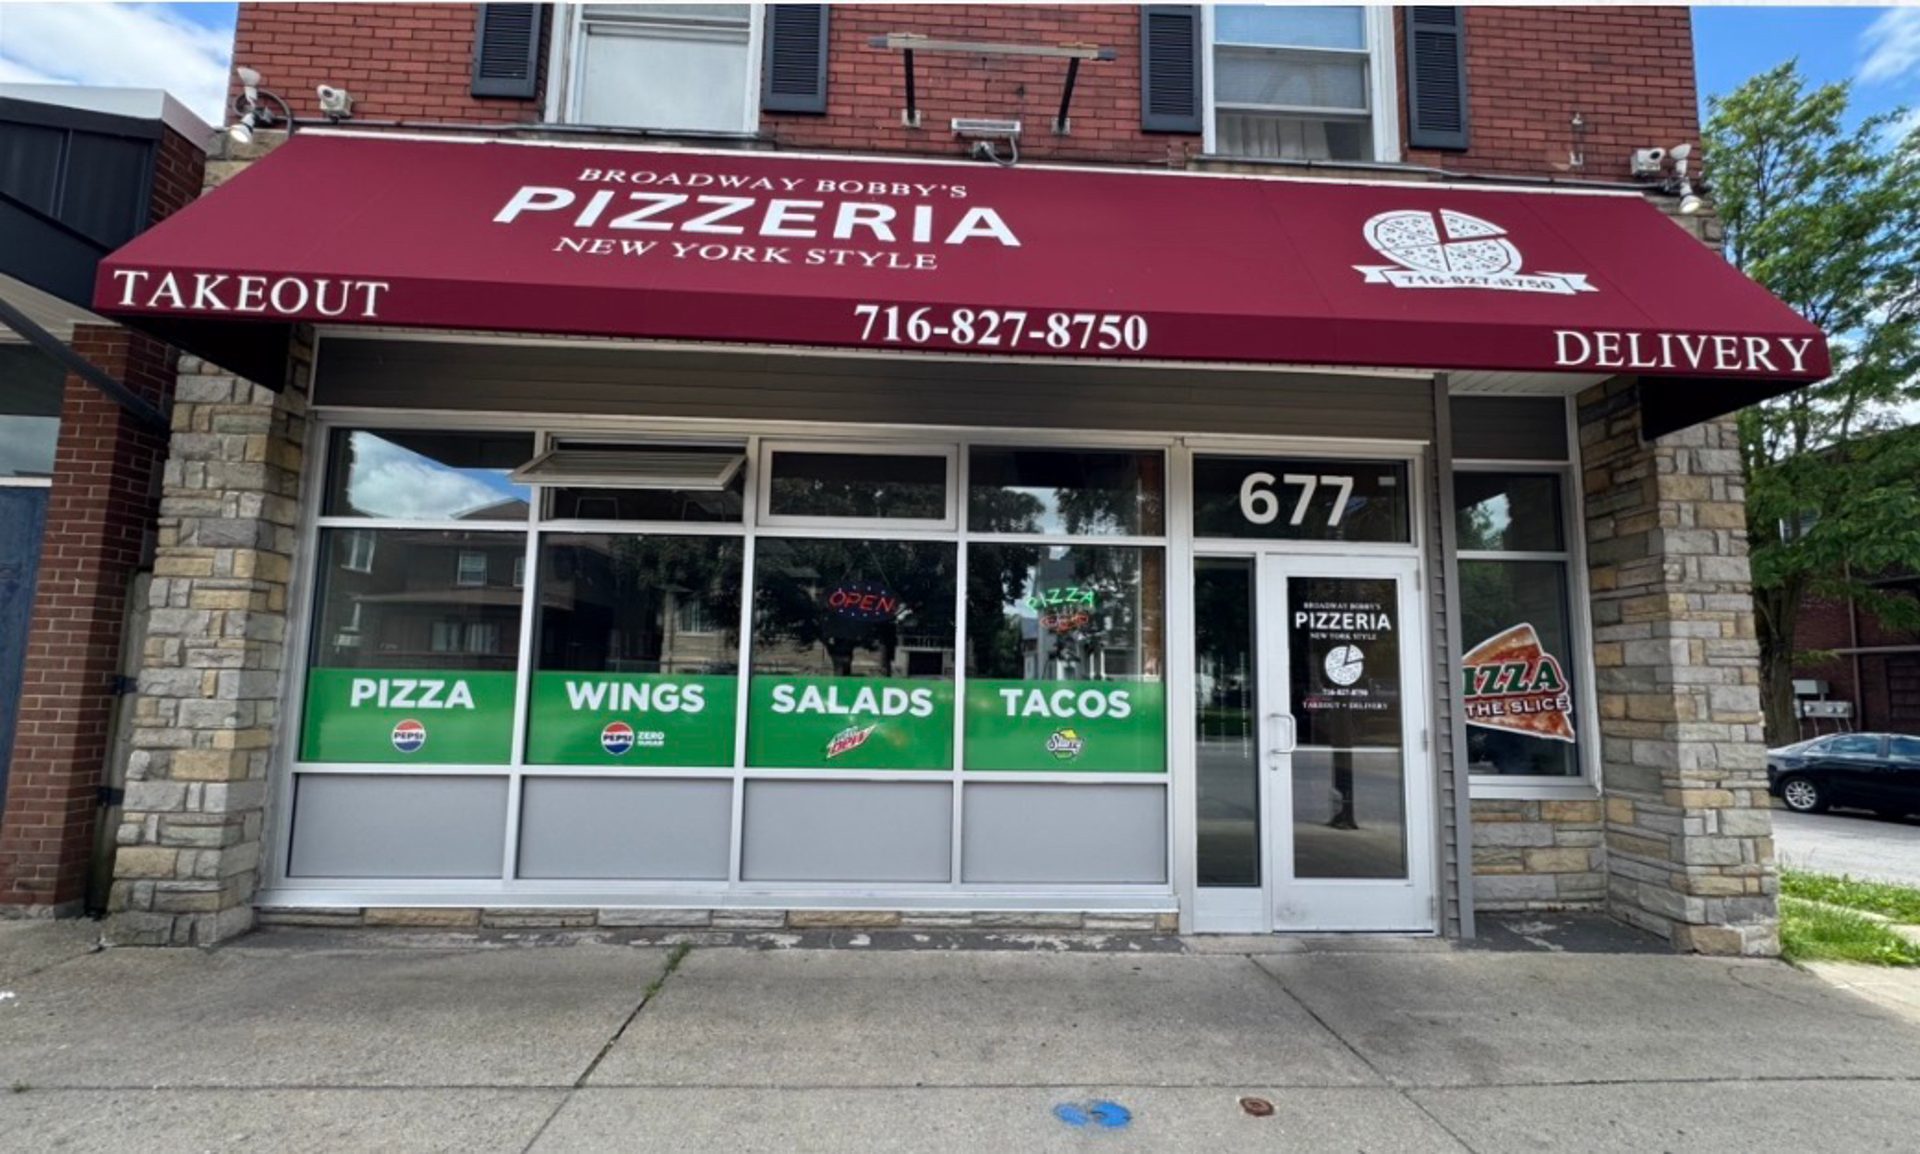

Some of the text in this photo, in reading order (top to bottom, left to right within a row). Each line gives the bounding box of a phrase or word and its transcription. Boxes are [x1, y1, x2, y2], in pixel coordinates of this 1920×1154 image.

[577, 167, 969, 200] BROADWAY BOBBY'S
[493, 185, 1021, 247] PIZZERIA
[551, 236, 938, 271] NEW YORK STYLE
[113, 269, 389, 318] TAKEOUT
[1402, 275, 1556, 290] 716-827-8750
[854, 303, 1148, 351] 716-827-8750
[1553, 329, 1813, 373] DELIVERY
[1239, 471, 1354, 527] 677
[829, 591, 896, 613] OPEN
[1025, 587, 1095, 616] PIZZA
[1303, 602, 1348, 610] BROADWAY
[1295, 611, 1392, 631] PIZZERIA
[350, 678, 476, 710] PIZZA
[1462, 660, 1563, 696] IZZA
[565, 681, 706, 714] WINGS
[771, 684, 934, 718] SALADS
[999, 687, 1132, 719] TACOS
[1466, 696, 1568, 717] THE SLICE
[603, 733, 633, 743] PEPSI
